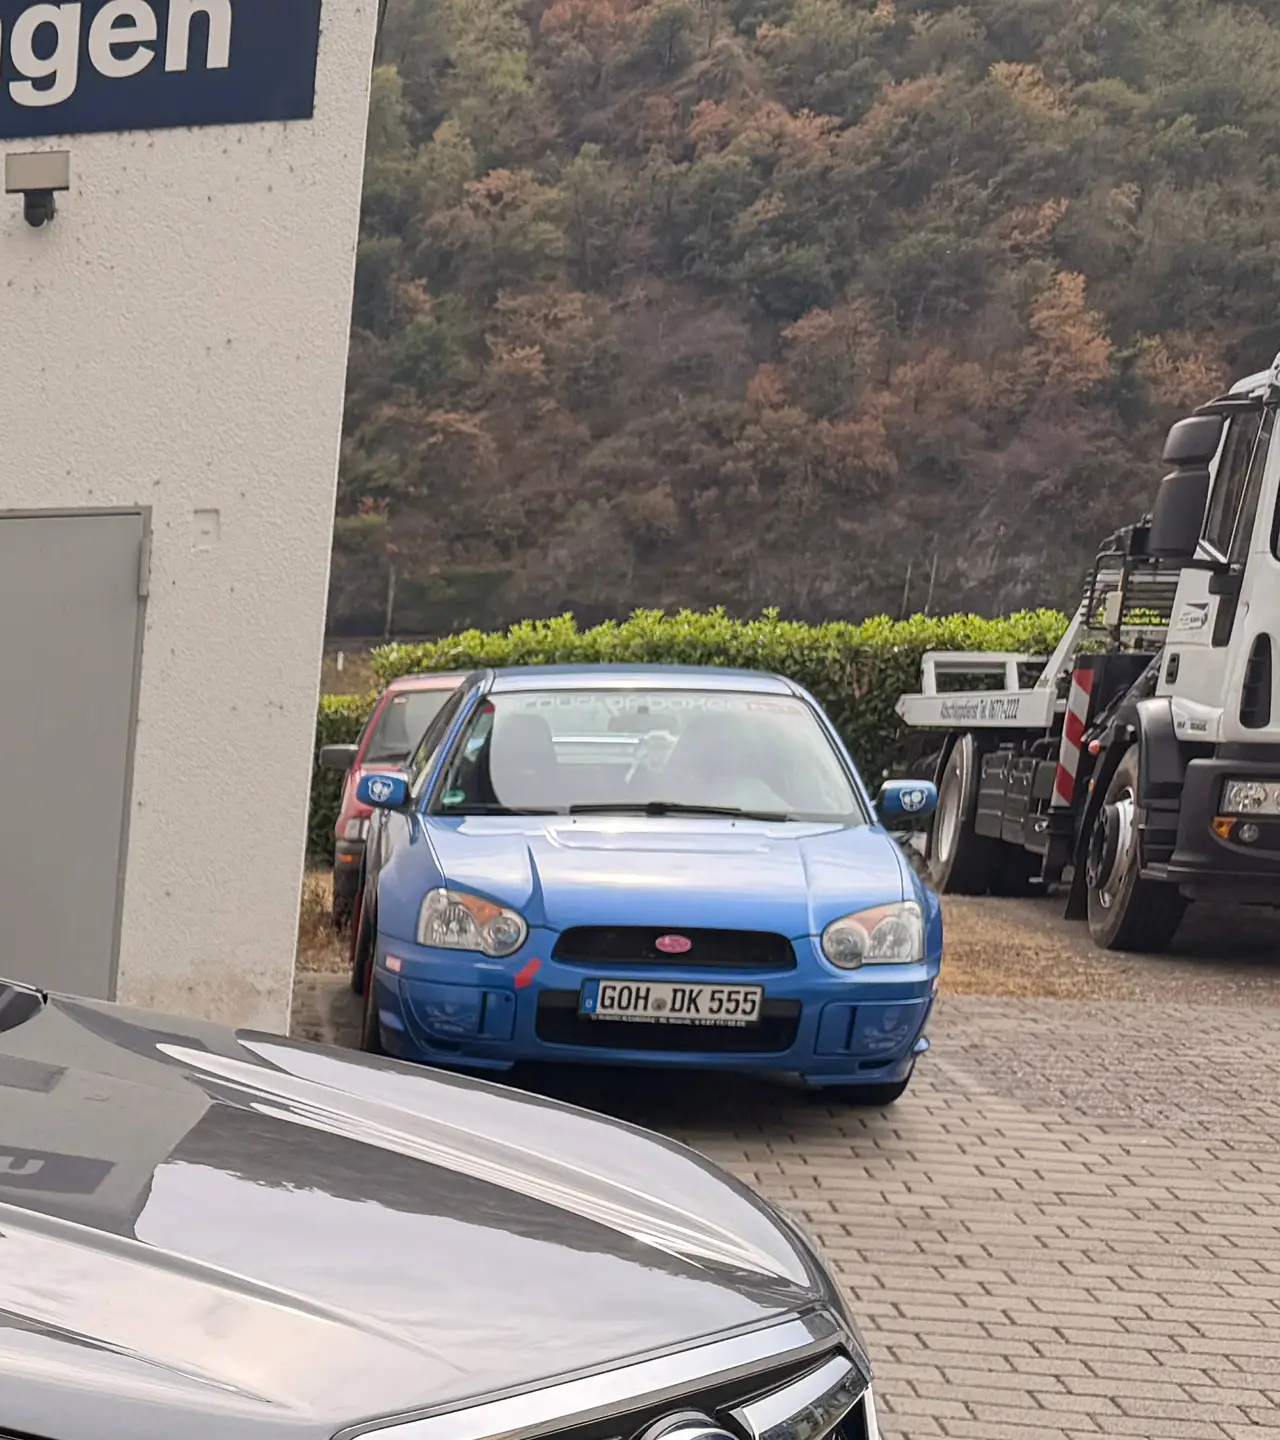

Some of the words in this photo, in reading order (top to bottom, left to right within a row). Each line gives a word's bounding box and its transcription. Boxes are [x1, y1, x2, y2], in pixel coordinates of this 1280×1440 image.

[599, 984, 651, 1012] GOH
[669, 988, 704, 1014] DK
[708, 989, 758, 1016] 555
